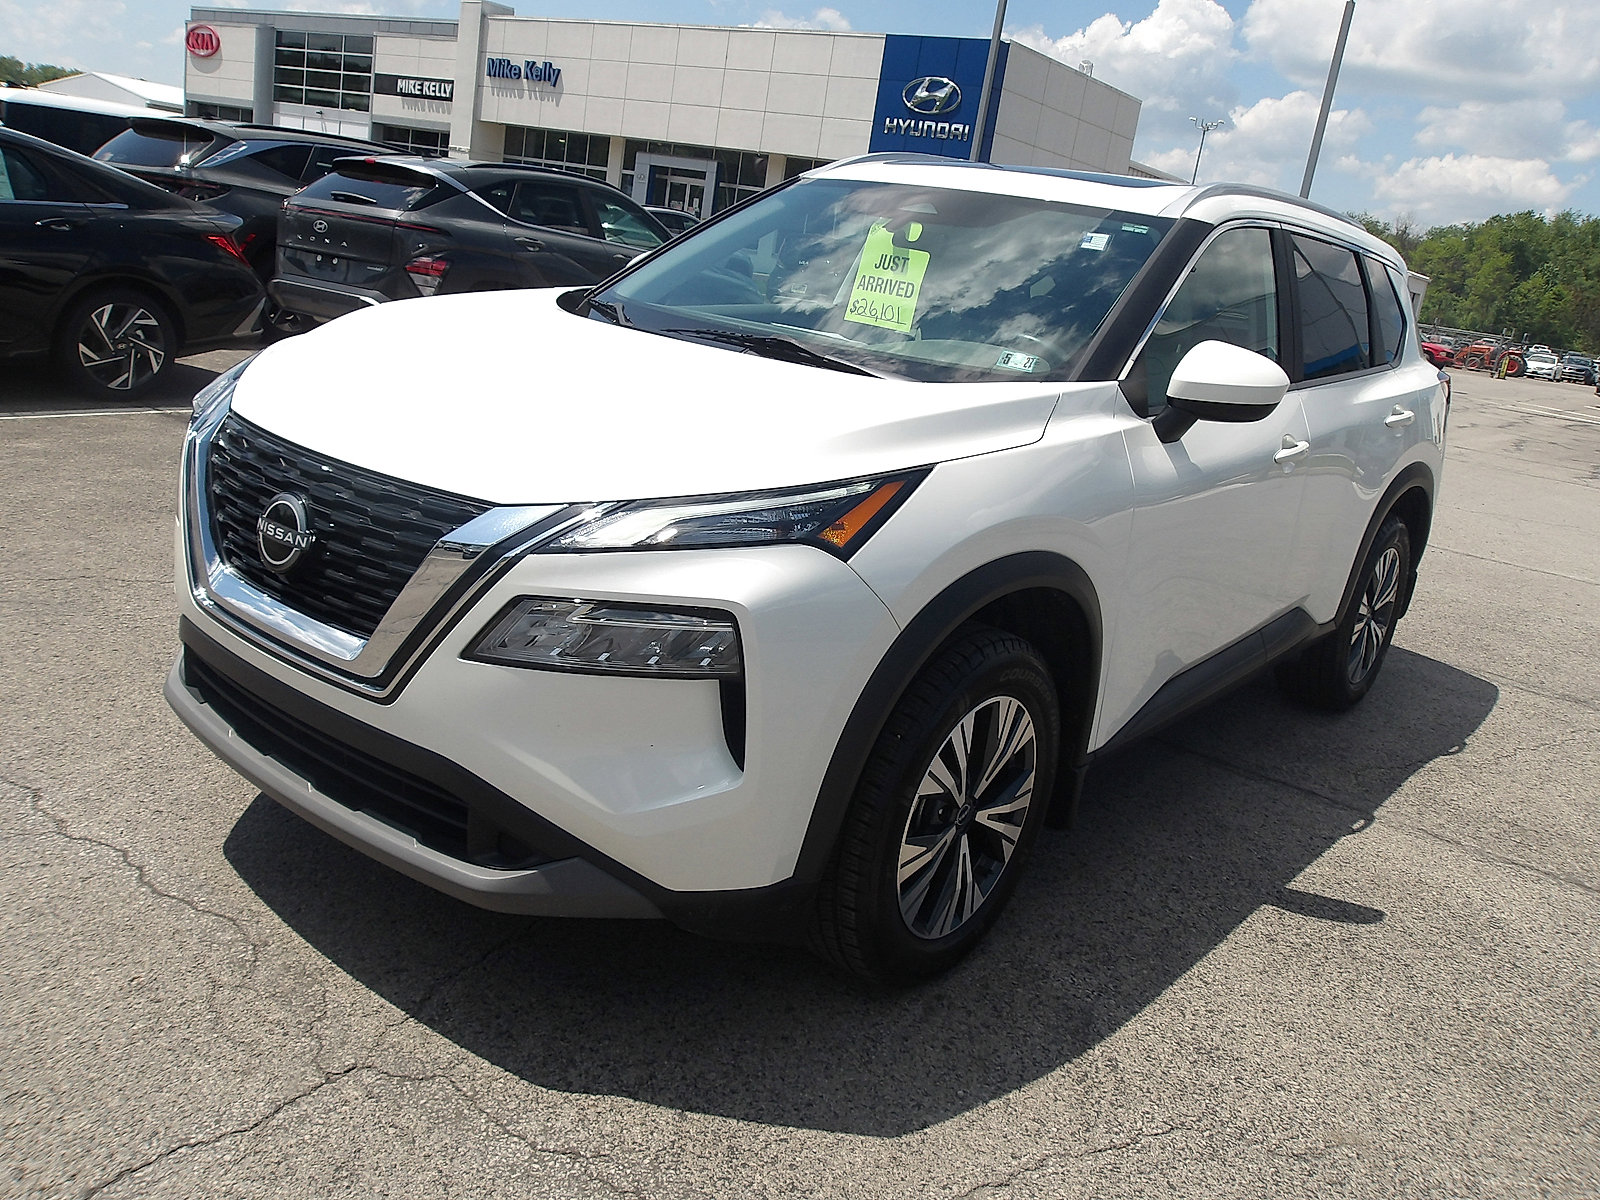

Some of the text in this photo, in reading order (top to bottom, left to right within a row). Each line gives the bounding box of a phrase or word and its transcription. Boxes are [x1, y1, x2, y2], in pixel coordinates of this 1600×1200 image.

[188, 31, 215, 51] KIA
[486, 57, 561, 88] Mike Kelly
[396, 78, 453, 98] MIKE KELLY
[883, 117, 970, 142] HYUNDAI
[296, 233, 348, 248] KONA
[874, 253, 910, 273] JUST
[856, 274, 915, 299] ARRIVED
[849, 298, 903, 324] $26,101
[1022, 357, 1035, 369] 27
[257, 517, 308, 548] NISSAN
